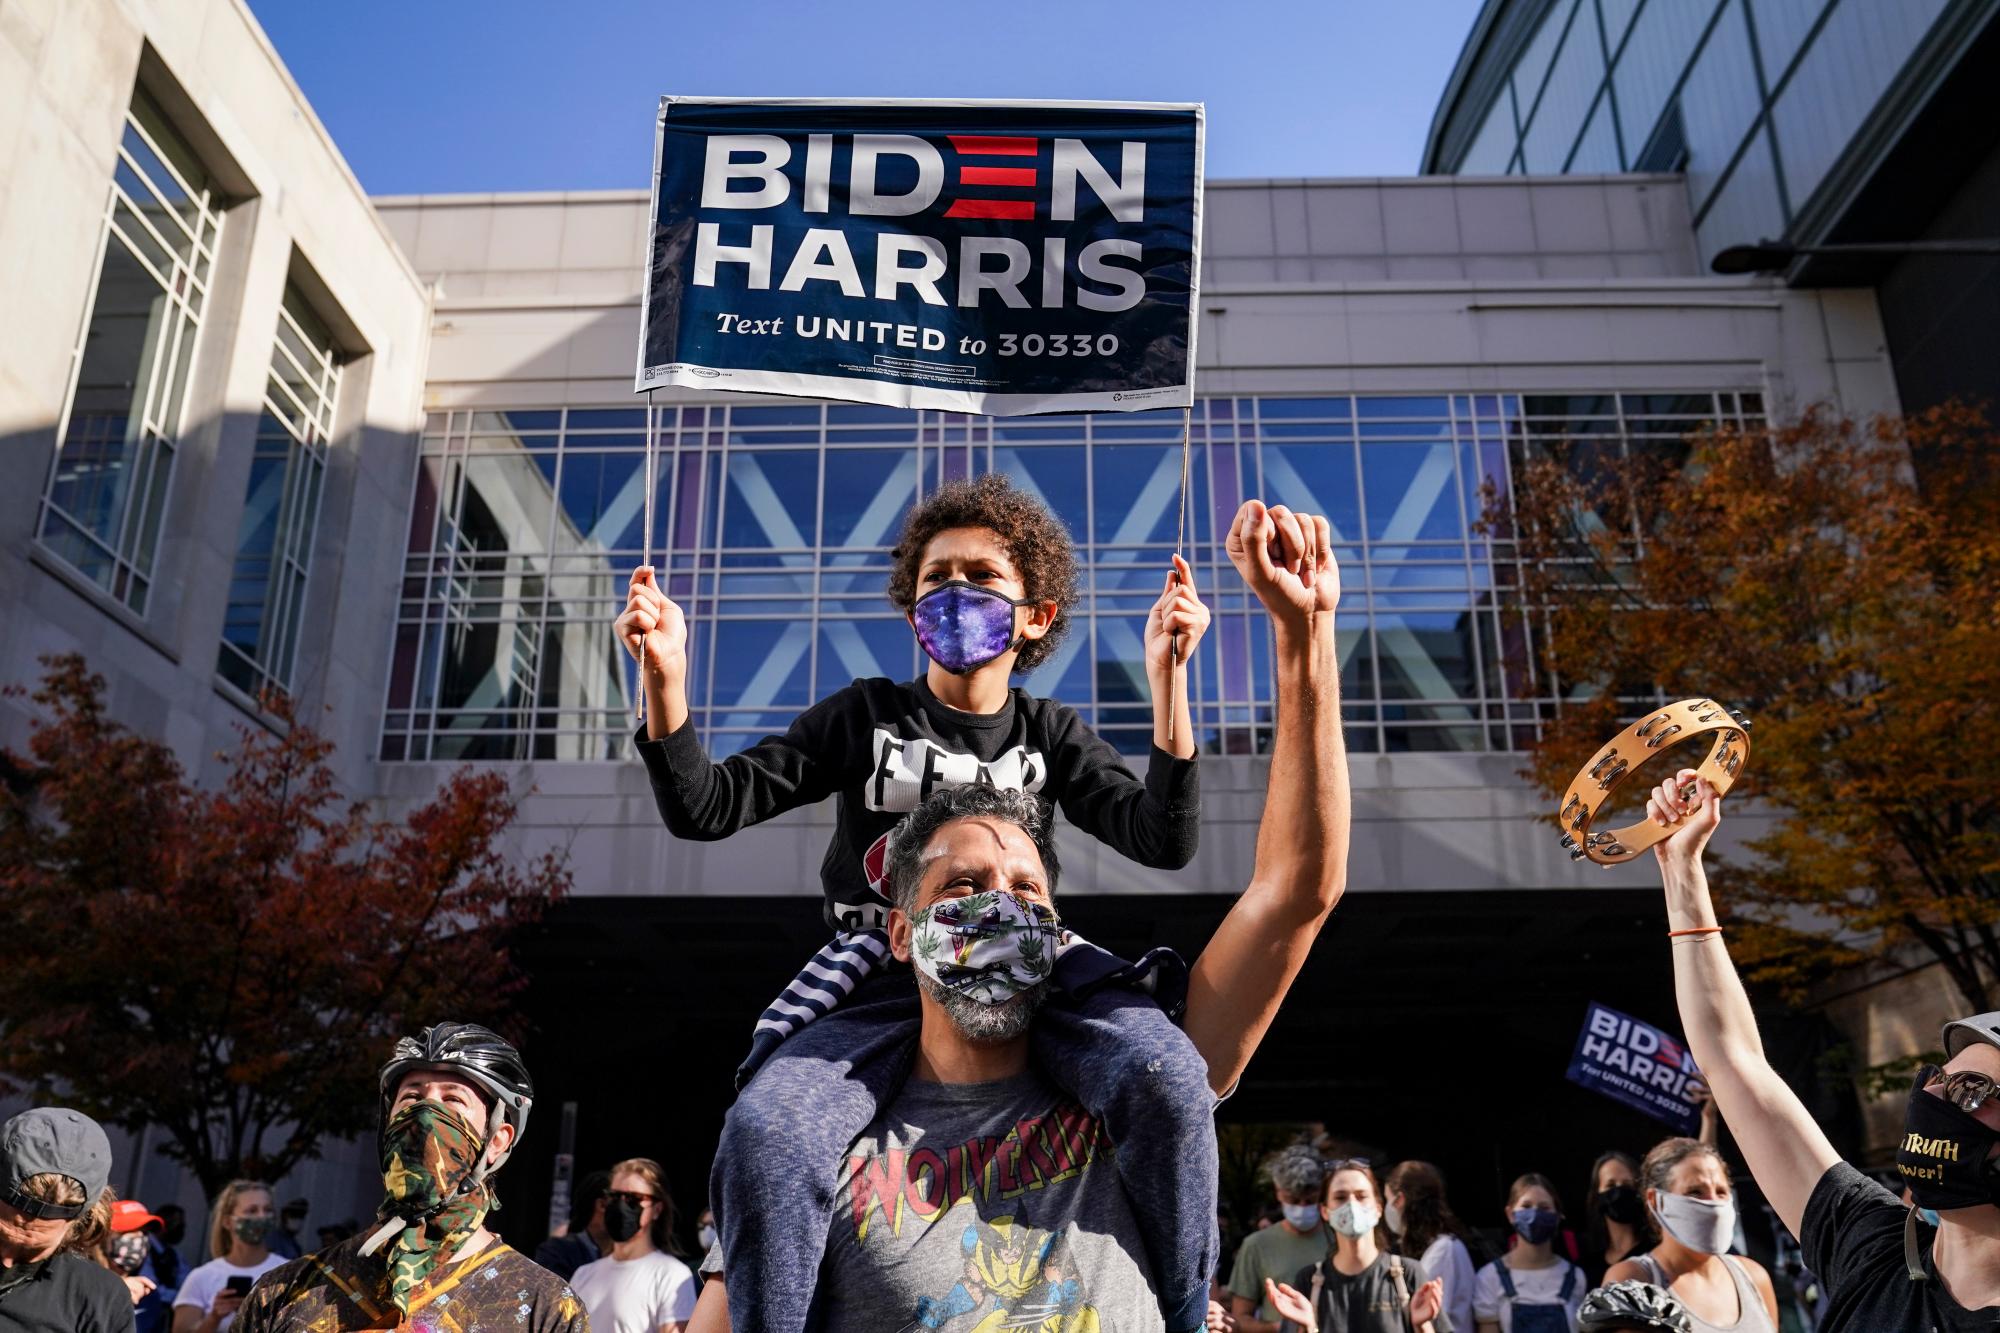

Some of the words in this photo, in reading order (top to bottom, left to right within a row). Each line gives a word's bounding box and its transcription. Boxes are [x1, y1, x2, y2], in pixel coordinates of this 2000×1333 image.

[700, 133, 1147, 223] BIDEN
[692, 222, 1147, 313] HARRIS
[716, 312, 785, 336] Text
[796, 315, 946, 352] UNITED
[959, 335, 987, 356] to
[998, 333, 1120, 357] 30330
[1582, 1034, 1704, 1104] HARRIS
[1601, 1069, 1645, 1096] UNITED
[1905, 1133, 1959, 1162] TRUTH
